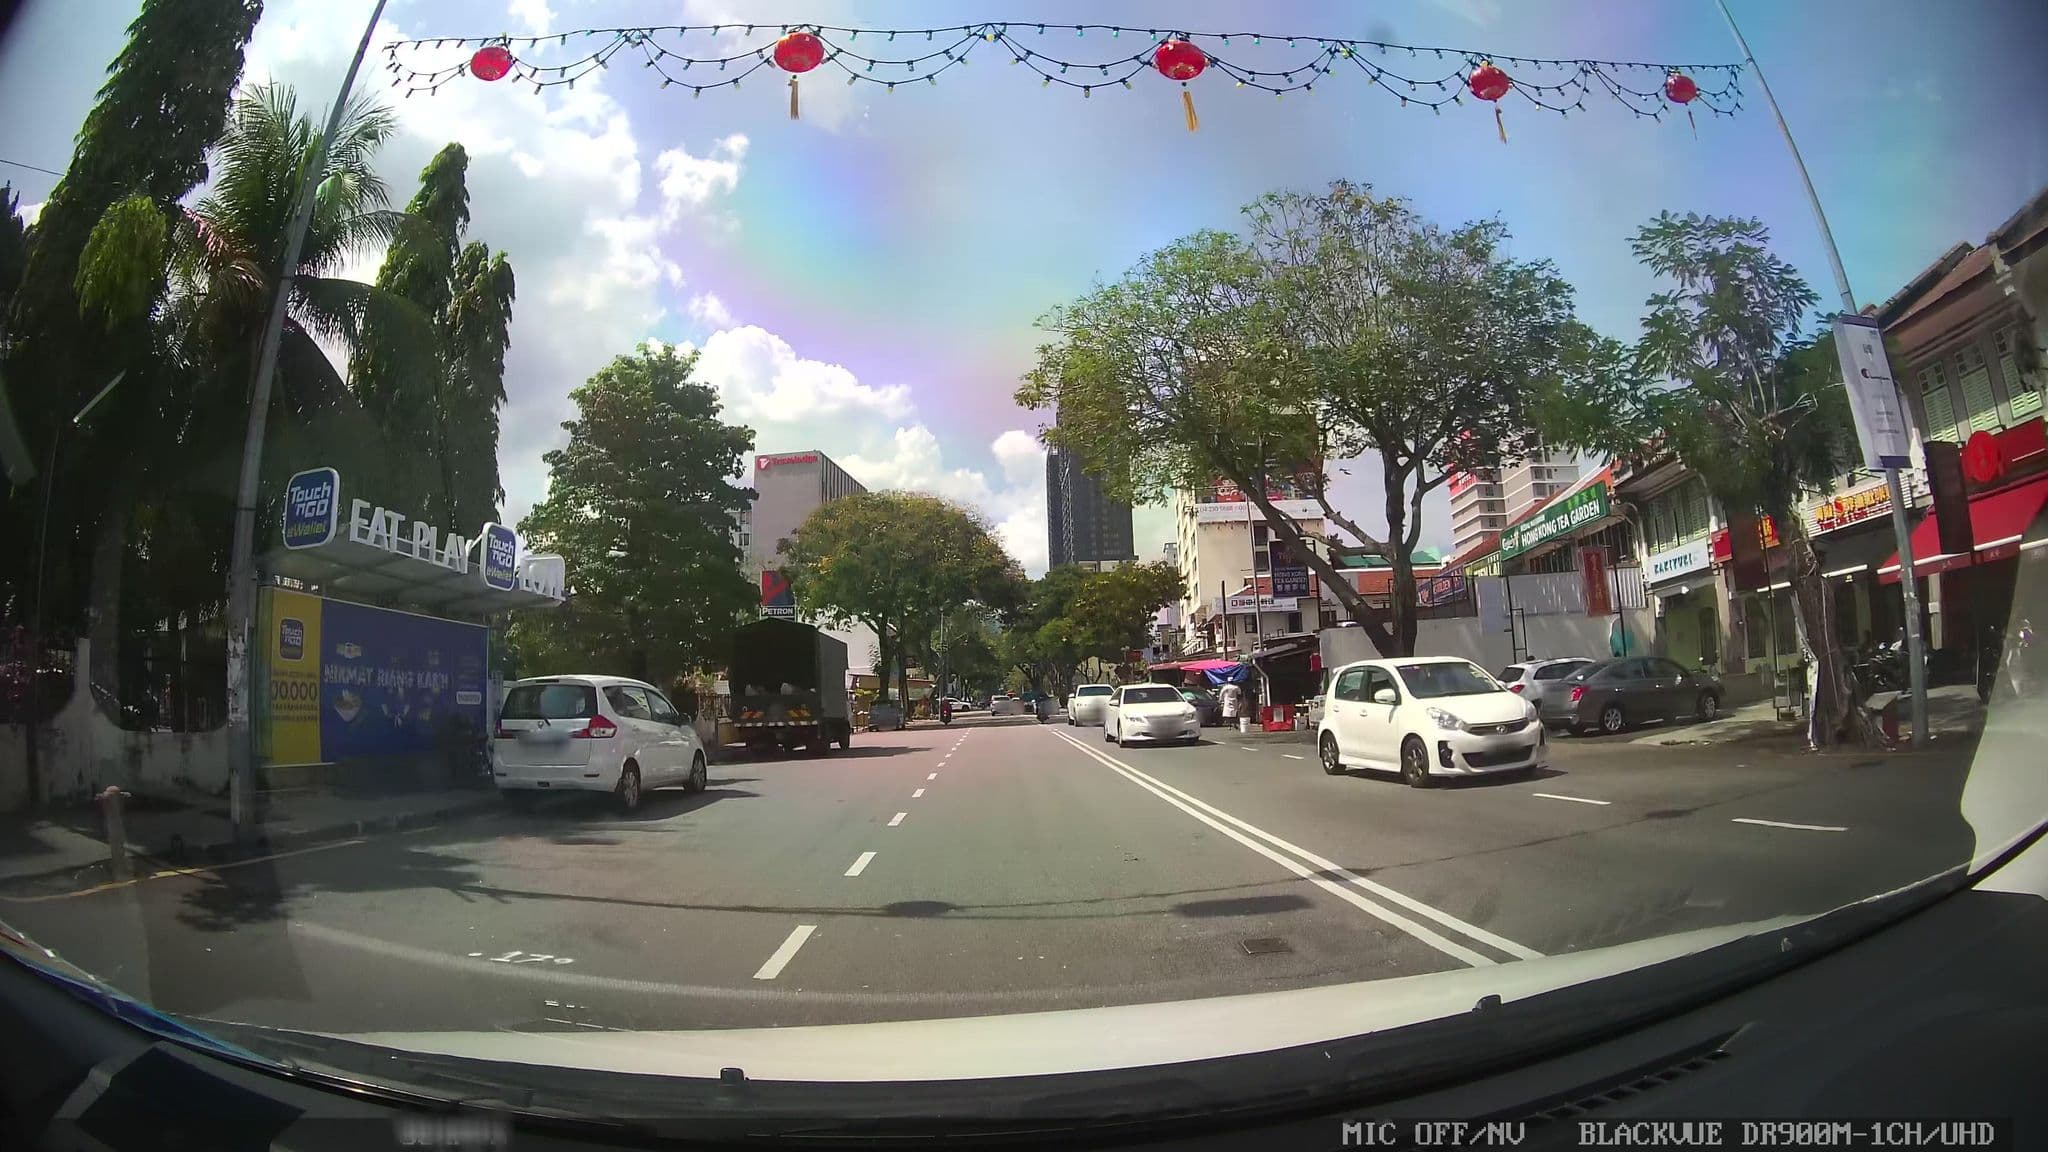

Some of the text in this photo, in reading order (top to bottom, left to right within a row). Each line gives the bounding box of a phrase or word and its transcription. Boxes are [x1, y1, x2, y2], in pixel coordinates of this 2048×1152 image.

[290, 482, 332, 504] Touch
[1557, 513, 1570, 531] TEA
[1570, 499, 1600, 525] GARDEN
[350, 498, 474, 574] EAT PLAY
[488, 533, 514, 554] Touch
[762, 607, 794, 615] PETRON
